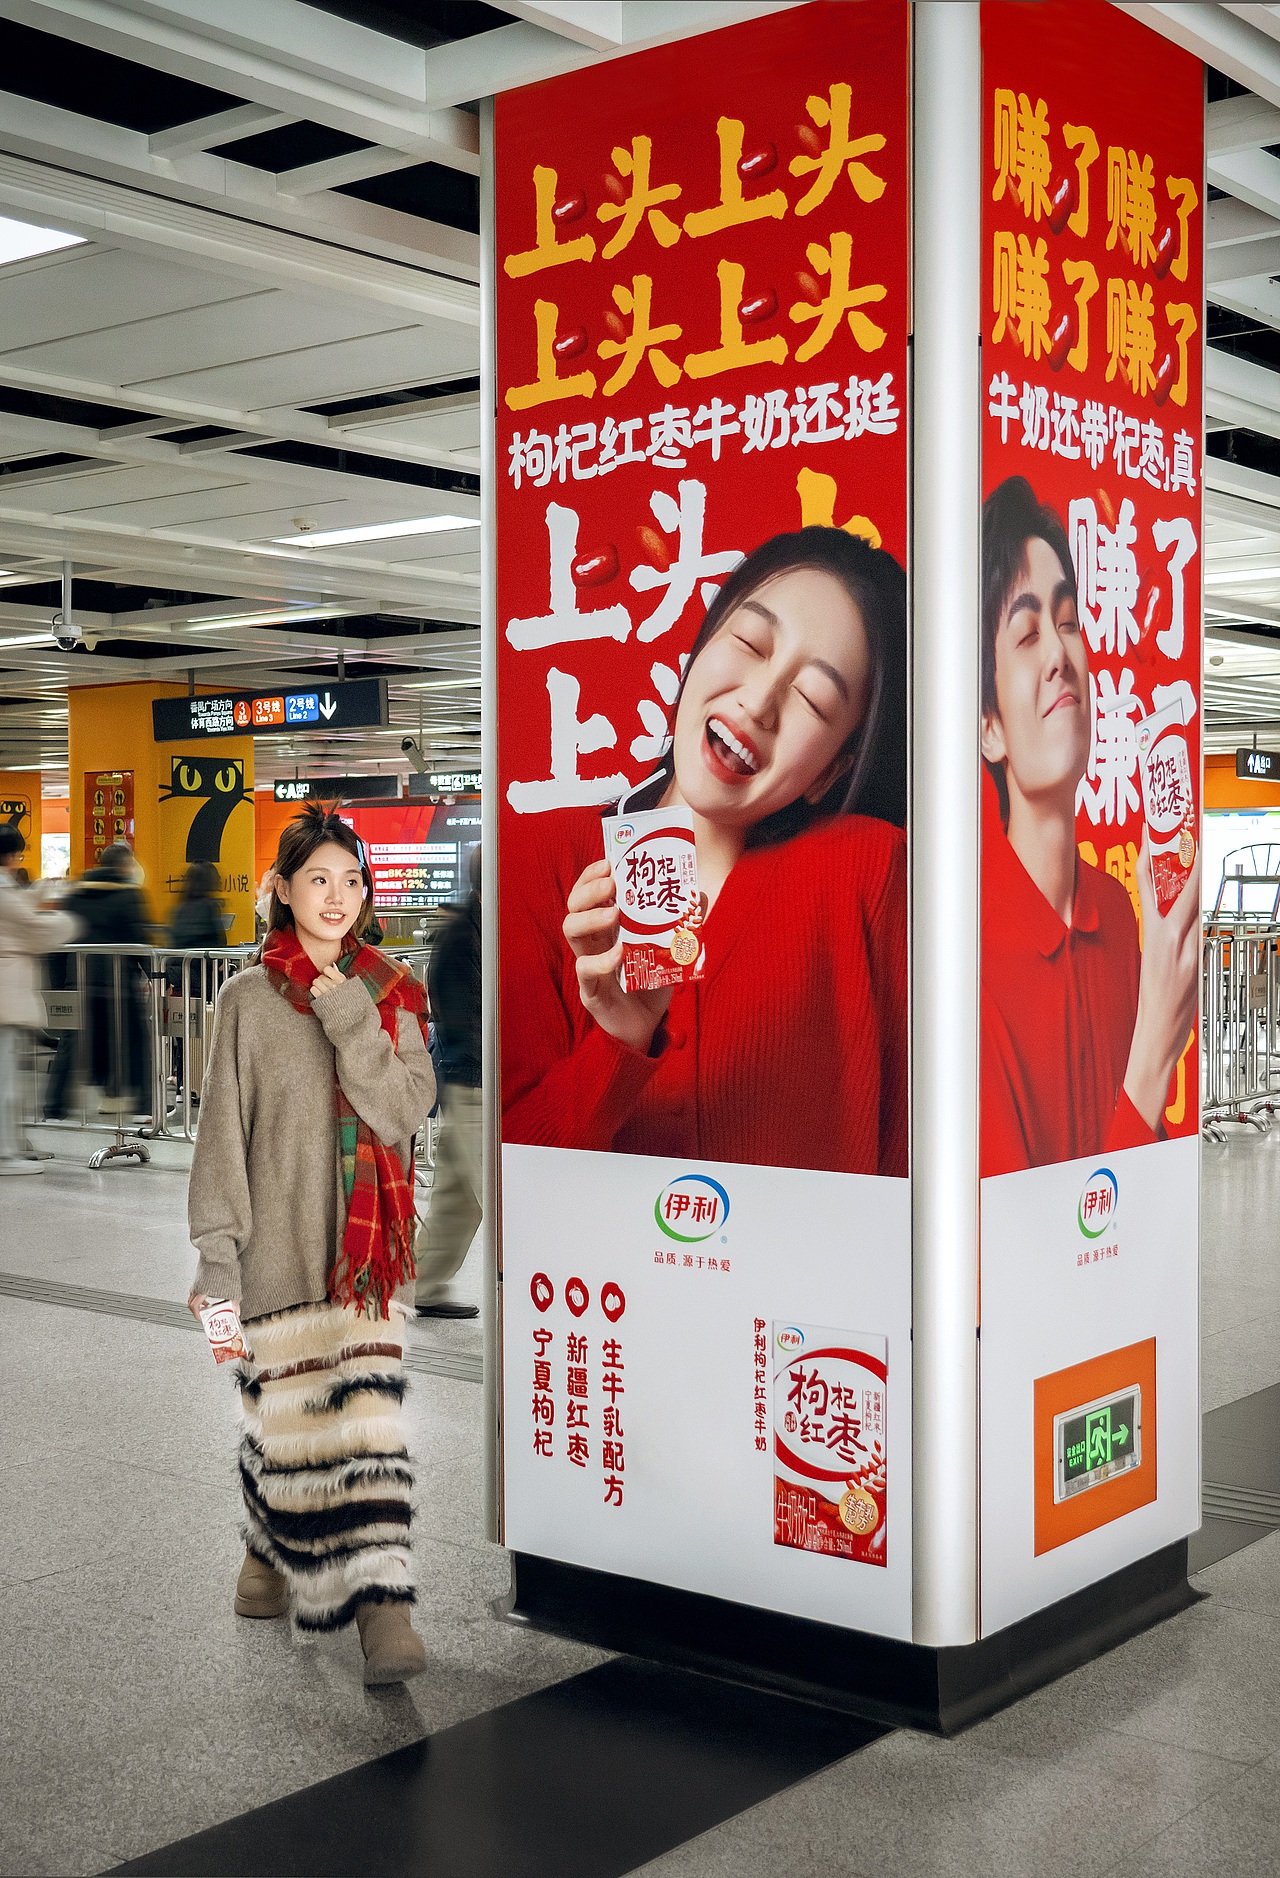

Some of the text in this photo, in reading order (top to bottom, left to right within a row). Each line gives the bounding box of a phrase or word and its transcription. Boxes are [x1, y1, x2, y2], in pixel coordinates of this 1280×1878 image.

[504, 83, 887, 279] 上头上头
[992, 88, 1198, 283] 赚了赚了
[505, 232, 888, 411] 上头上头
[992, 231, 1198, 407] 赚了赚了
[508, 373, 900, 489] 枸杞红枣牛奶还挺
[1068, 497, 1198, 661] 赚了
[256, 700, 281, 714] 3号线
[268, 714, 274, 722] 3
[289, 697, 315, 713] 2号线
[303, 711, 308, 719] 2
[664, 1193, 718, 1224] 伊利
[1083, 1187, 1112, 1219] 伊利
[780, 1333, 801, 1345] 伊利
[532, 1327, 554, 1458] 宁夏枸杞
[566, 1331, 590, 1468] 新疆红枣
[754, 1317, 767, 1452] 伊利枸杞红枣牛奶
[787, 1364, 857, 1416] 枸杞
[601, 1338, 625, 1506] 生牛乳配方
[800, 1411, 869, 1465] 红枣
[1066, 1440, 1085, 1458] 安全出口
[1068, 1454, 1083, 1467] EXIT
